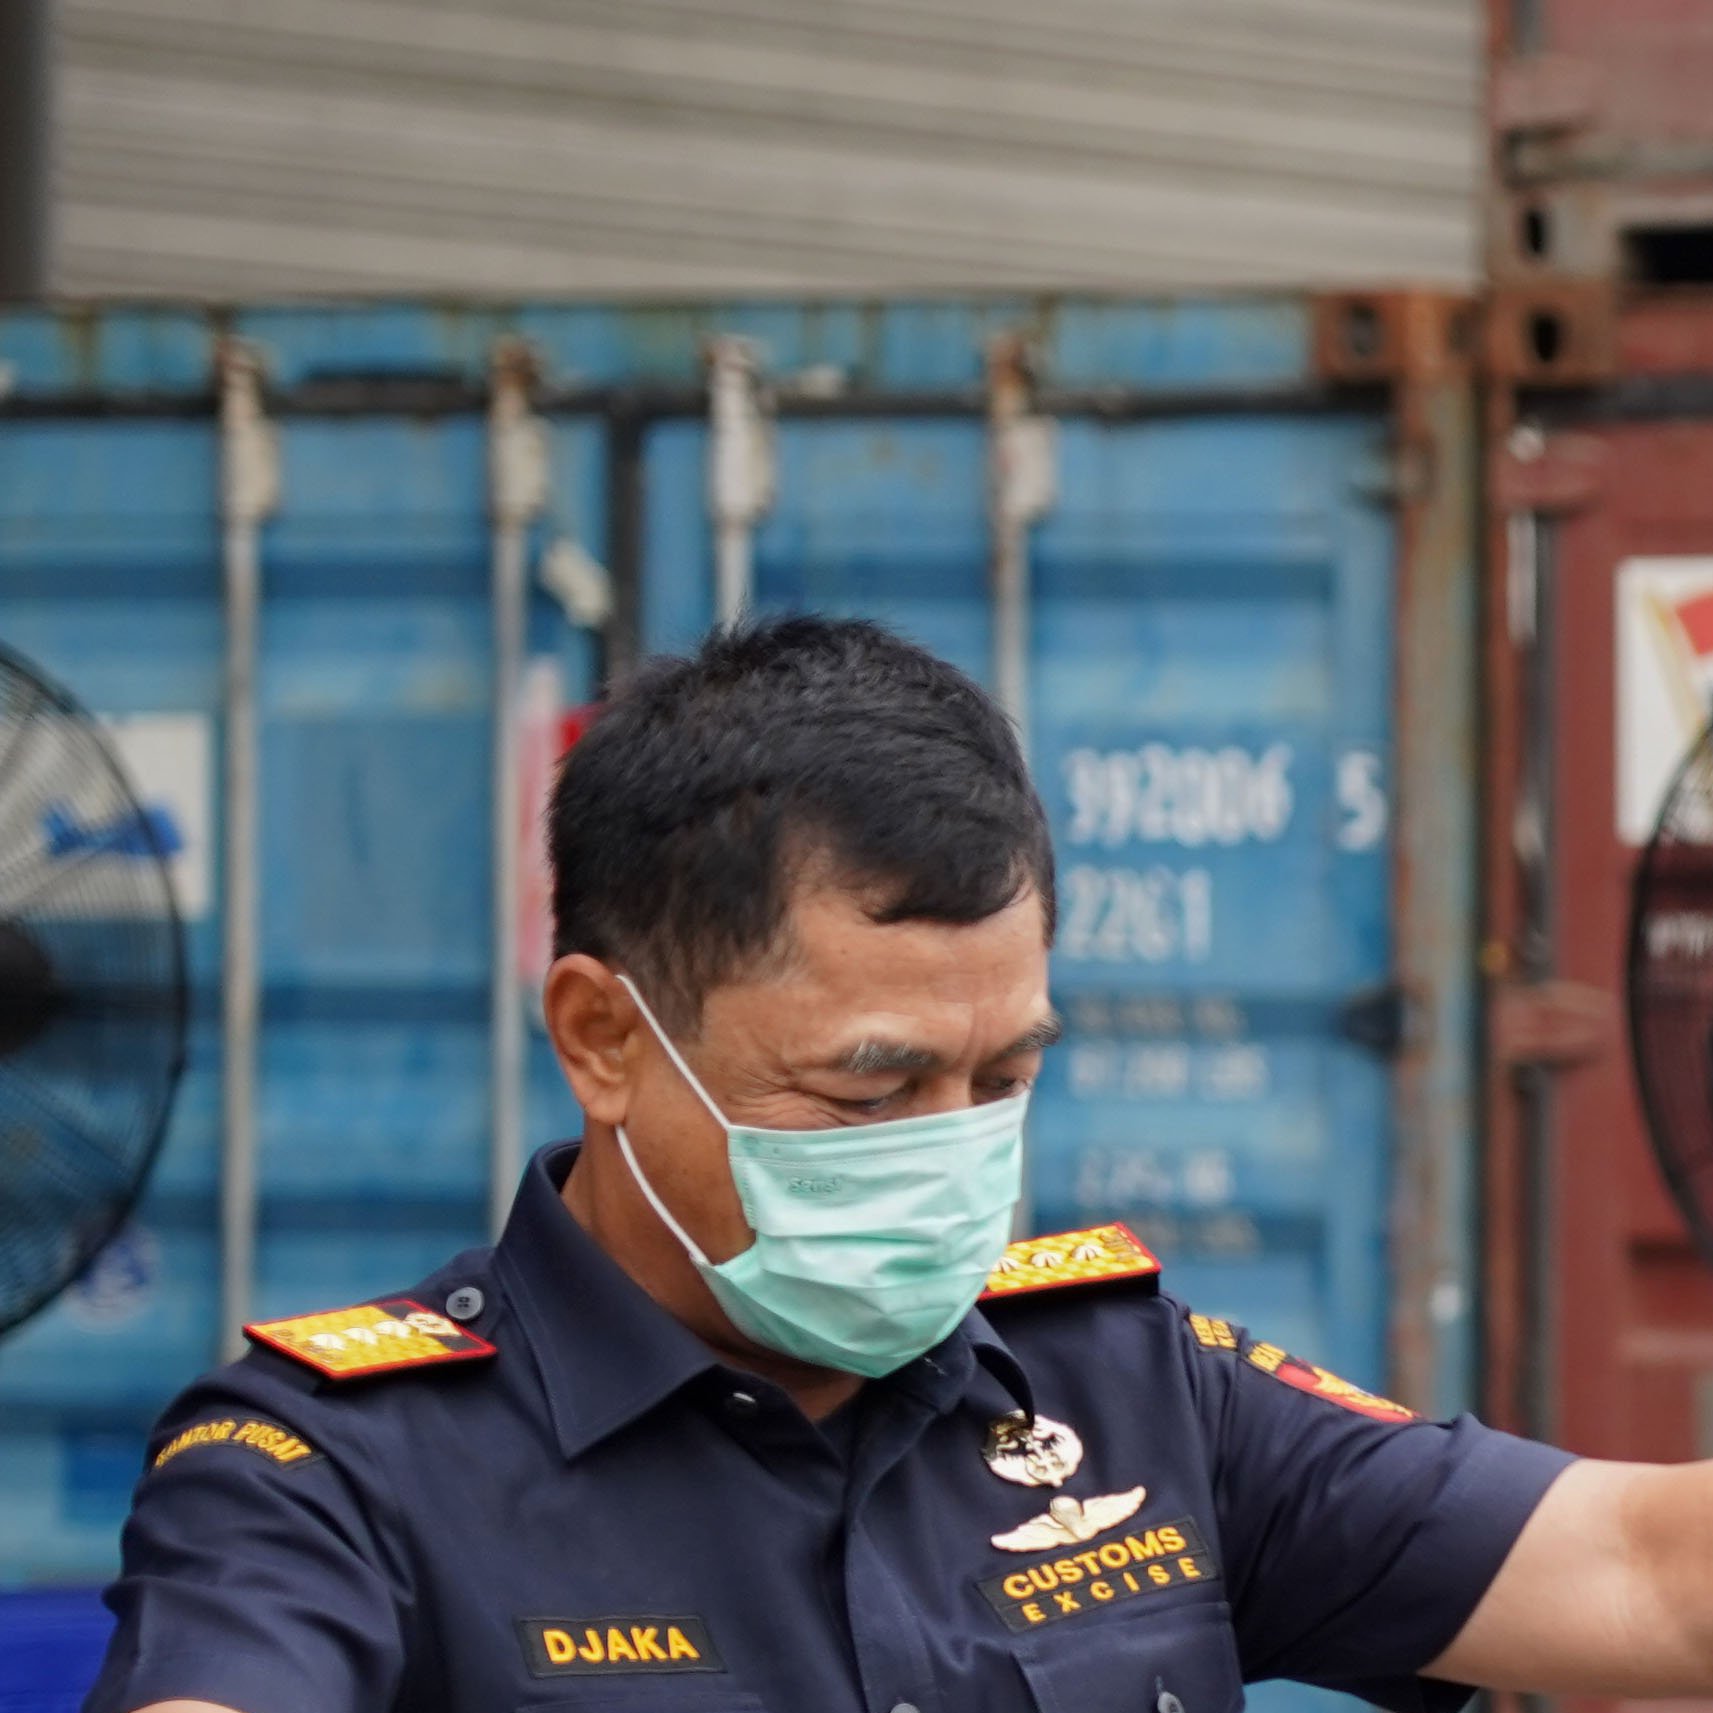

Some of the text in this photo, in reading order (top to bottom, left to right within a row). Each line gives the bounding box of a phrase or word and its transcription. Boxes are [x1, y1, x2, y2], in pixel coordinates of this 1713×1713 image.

[232, 1422, 312, 1463] PUSAT
[1002, 1526, 1187, 1599] CUSTOMS
[1021, 1556, 1201, 1623] EXCISE
[543, 1626, 701, 1664] DJAKA
